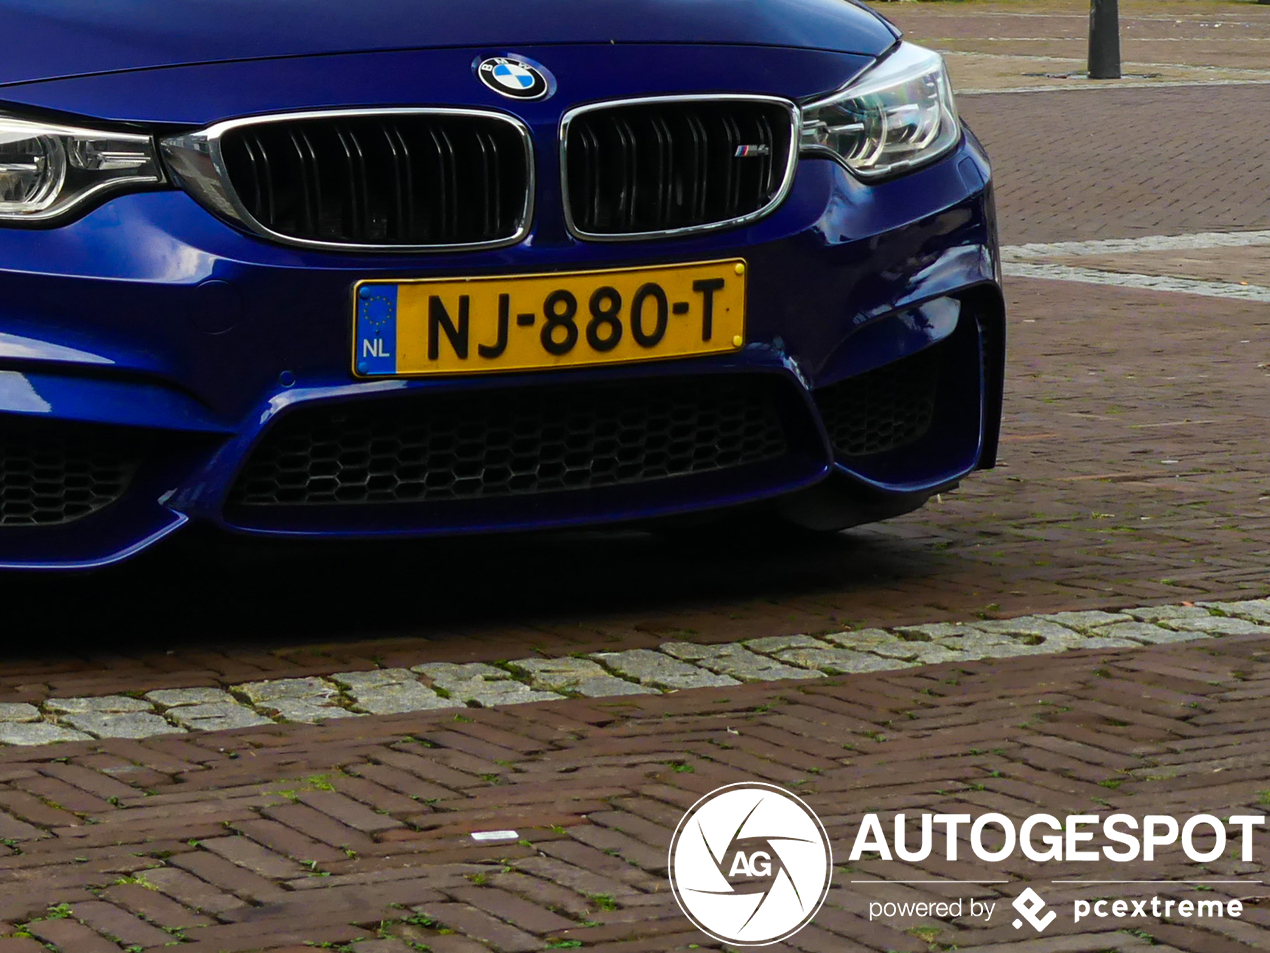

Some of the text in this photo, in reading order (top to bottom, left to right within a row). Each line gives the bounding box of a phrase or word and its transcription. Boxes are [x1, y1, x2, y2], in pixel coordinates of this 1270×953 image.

[481, 57, 532, 72] BMW
[427, 277, 726, 360] NJ-880-T
[362, 337, 391, 359] NL
